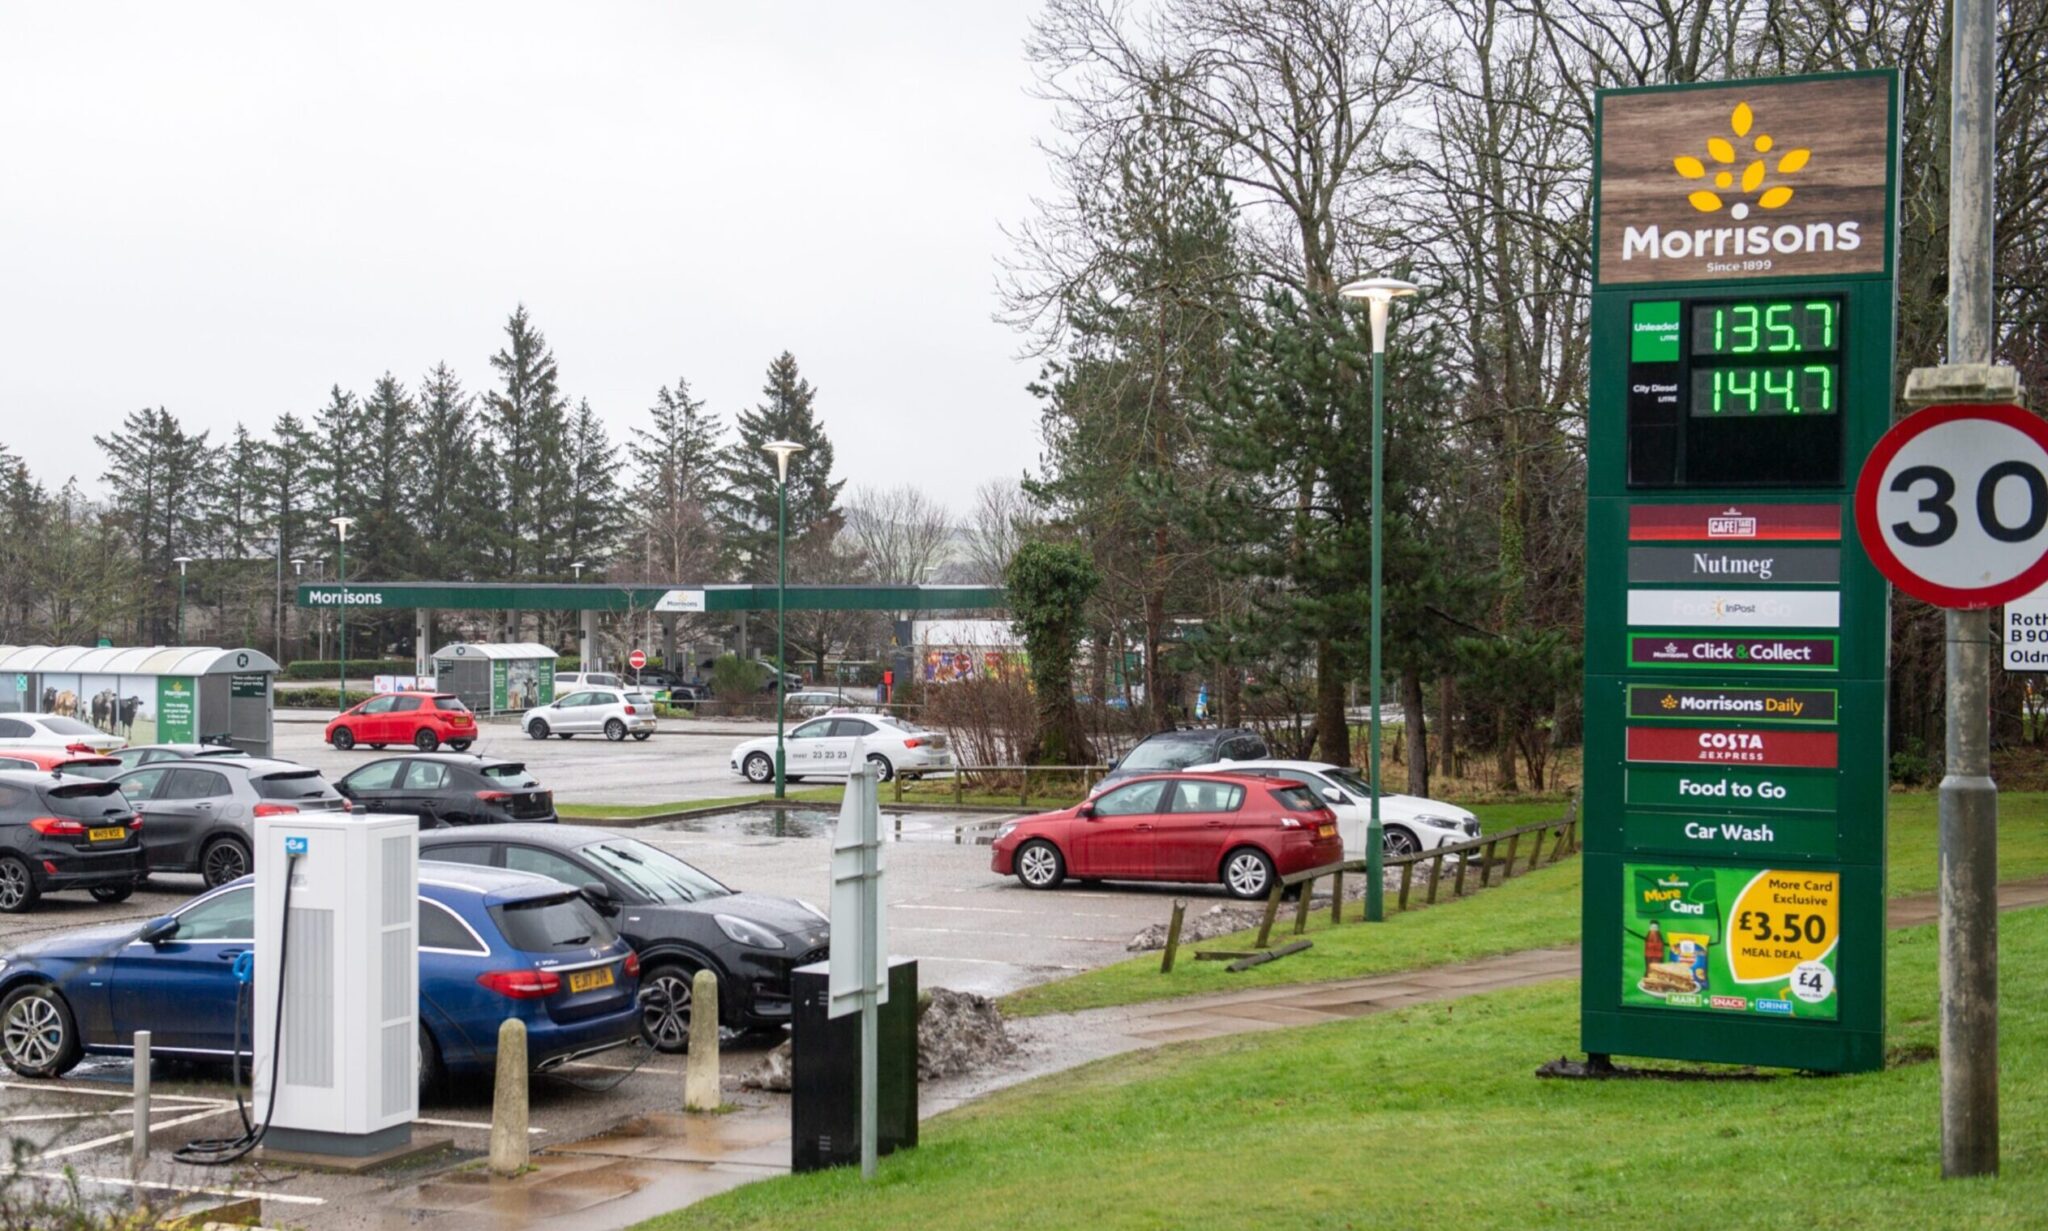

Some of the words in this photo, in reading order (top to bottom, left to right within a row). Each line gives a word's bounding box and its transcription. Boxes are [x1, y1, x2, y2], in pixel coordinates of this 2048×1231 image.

[1622, 203, 1861, 260] Morrisons
[1706, 261, 1740, 273] Since
[1743, 259, 1772, 271] 1899
[1633, 321, 1679, 332] Unleaded
[1714, 302, 1831, 353] 135.7
[1633, 384, 1650, 394] City
[1651, 383, 1677, 393] Diesel
[1713, 366, 1830, 413] 144.7
[1889, 459, 2048, 548] 30
[1693, 553, 1774, 579] Nutmeg
[309, 588, 382, 604] Morrisons
[1725, 603, 1756, 613] InPost
[2011, 629, 2022, 642] B
[1692, 643, 1734, 660] Click
[1735, 644, 1749, 660] &
[1750, 643, 1811, 661] Collect
[1680, 695, 1763, 712] Morrisons
[1765, 698, 1803, 716] Daily
[1698, 732, 1764, 750] COSTA
[812, 751, 822, 759] 23
[824, 751, 835, 759] 23
[837, 751, 847, 759] 23
[1708, 751, 1764, 761] EXPRESS
[1679, 779, 1726, 796] Food
[1730, 782, 1752, 798] to
[1757, 781, 1786, 799] Go
[1684, 822, 1717, 839] Car
[1721, 824, 1774, 842] Wash
[1768, 879, 1800, 891] More
[1804, 880, 1833, 892] Card
[1644, 888, 1682, 903] More
[1773, 894, 1829, 907] Exclusive
[1670, 900, 1704, 915] Card
[1739, 911, 1827, 944] £3.50
[1742, 947, 1773, 959] MEAL
[1775, 949, 1803, 960] DEAL
[1799, 972, 1823, 993] £4
[1671, 995, 1697, 1004] MAIN
[1712, 998, 1745, 1008] SNACK
[1759, 1001, 1790, 1011] DRINK
